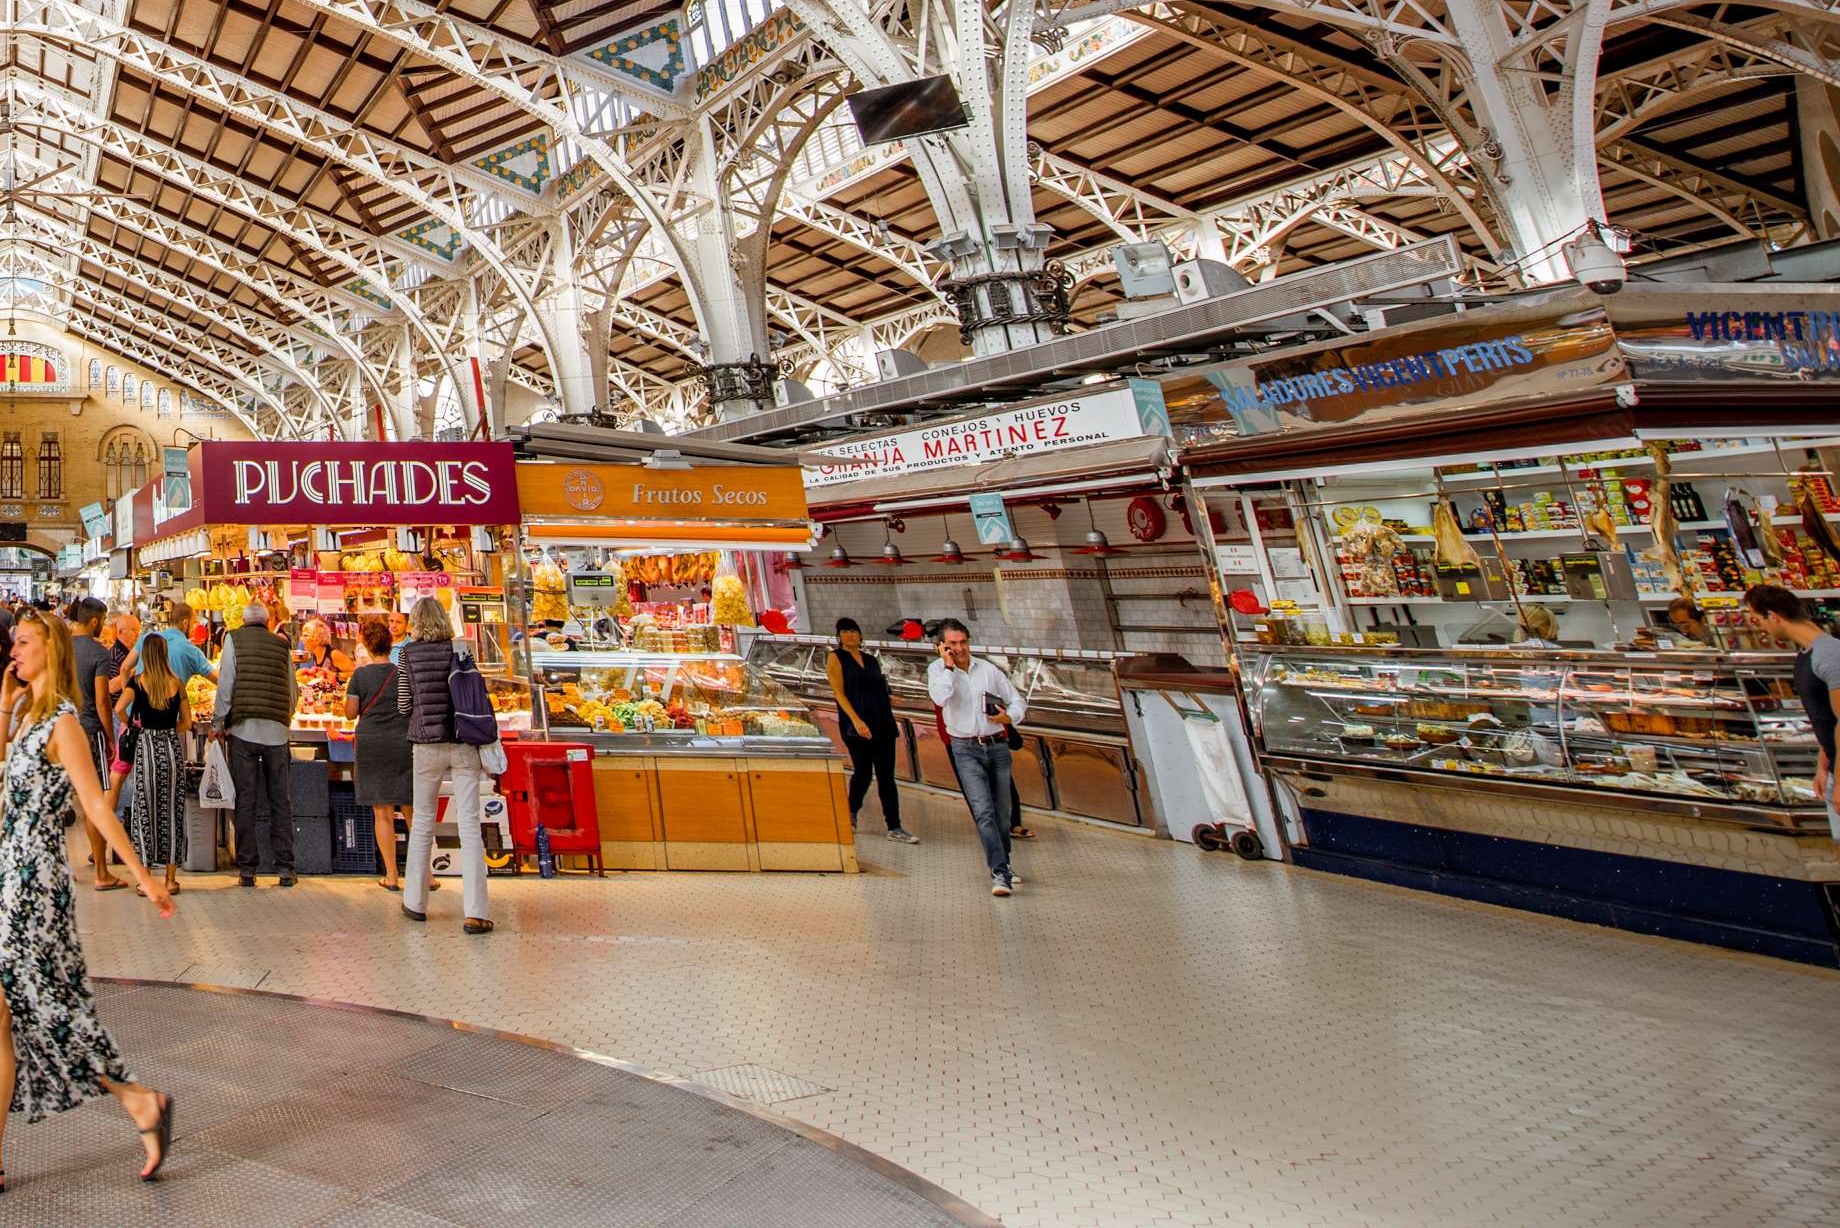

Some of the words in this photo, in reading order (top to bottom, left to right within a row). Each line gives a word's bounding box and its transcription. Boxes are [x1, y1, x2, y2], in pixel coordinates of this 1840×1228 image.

[1687, 312, 1805, 341] VICENT
[840, 438, 898, 455] SELECTAS
[922, 420, 988, 441] CONEJOS
[1014, 402, 1081, 422] HUEVOS
[924, 417, 1070, 459] MARTINEZ
[824, 472, 859, 482] CALIDAD
[882, 465, 901, 473] SUS
[906, 455, 969, 469] PRODUCTOS
[989, 443, 1035, 456] ATENTO
[1044, 432, 1110, 447] PERSONAL
[233, 460, 491, 505] PUCHADES
[632, 484, 702, 504] Frutos
[712, 484, 768, 505] Secos
